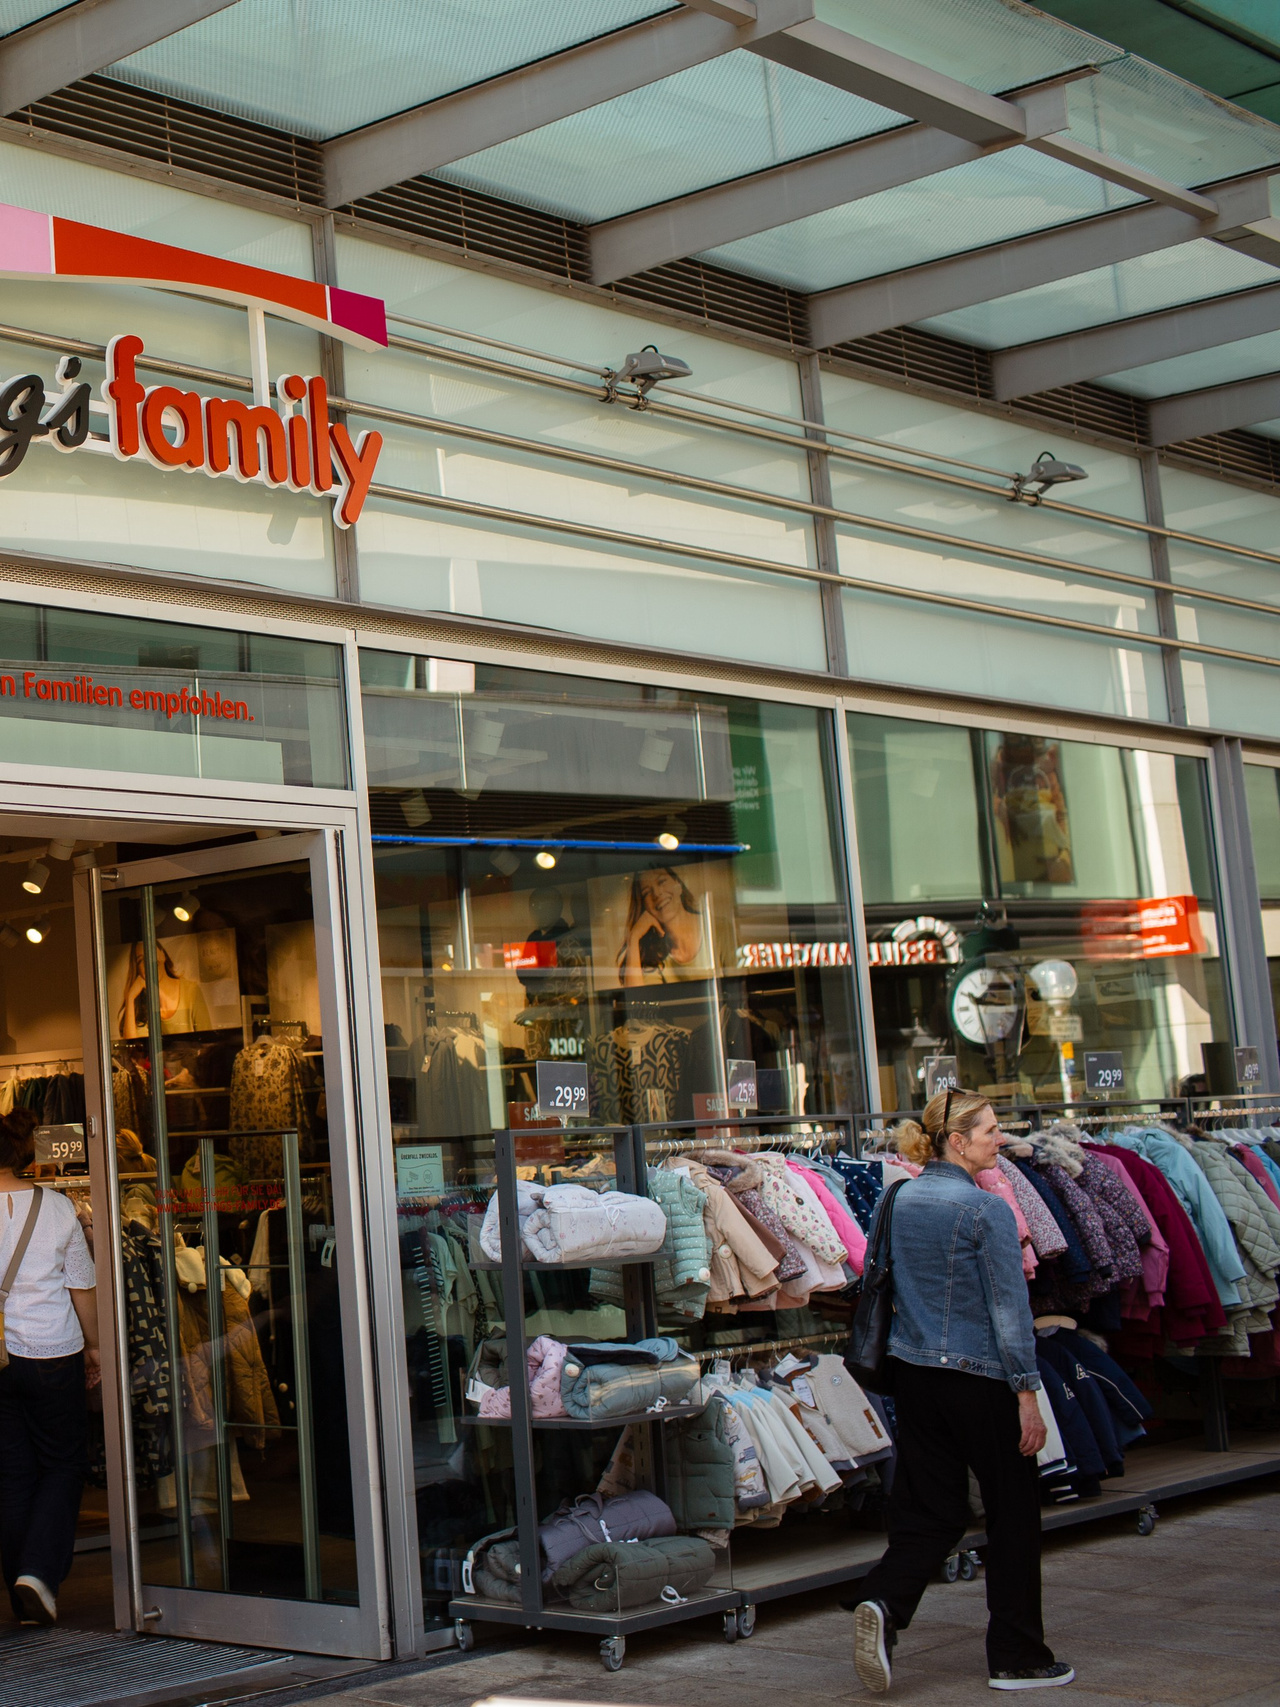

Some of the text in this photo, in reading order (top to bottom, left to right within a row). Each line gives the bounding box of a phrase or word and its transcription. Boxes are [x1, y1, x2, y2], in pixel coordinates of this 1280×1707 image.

[106, 335, 383, 527] family
[24, 671, 123, 707] Familien
[130, 686, 255, 721] empfohlen.
[555, 1085, 586, 1111] 29,99
[51, 1140, 83, 1159] 59,99
[231, 1184, 249, 1197] FÜR
[251, 1185, 264, 1196] SIE
